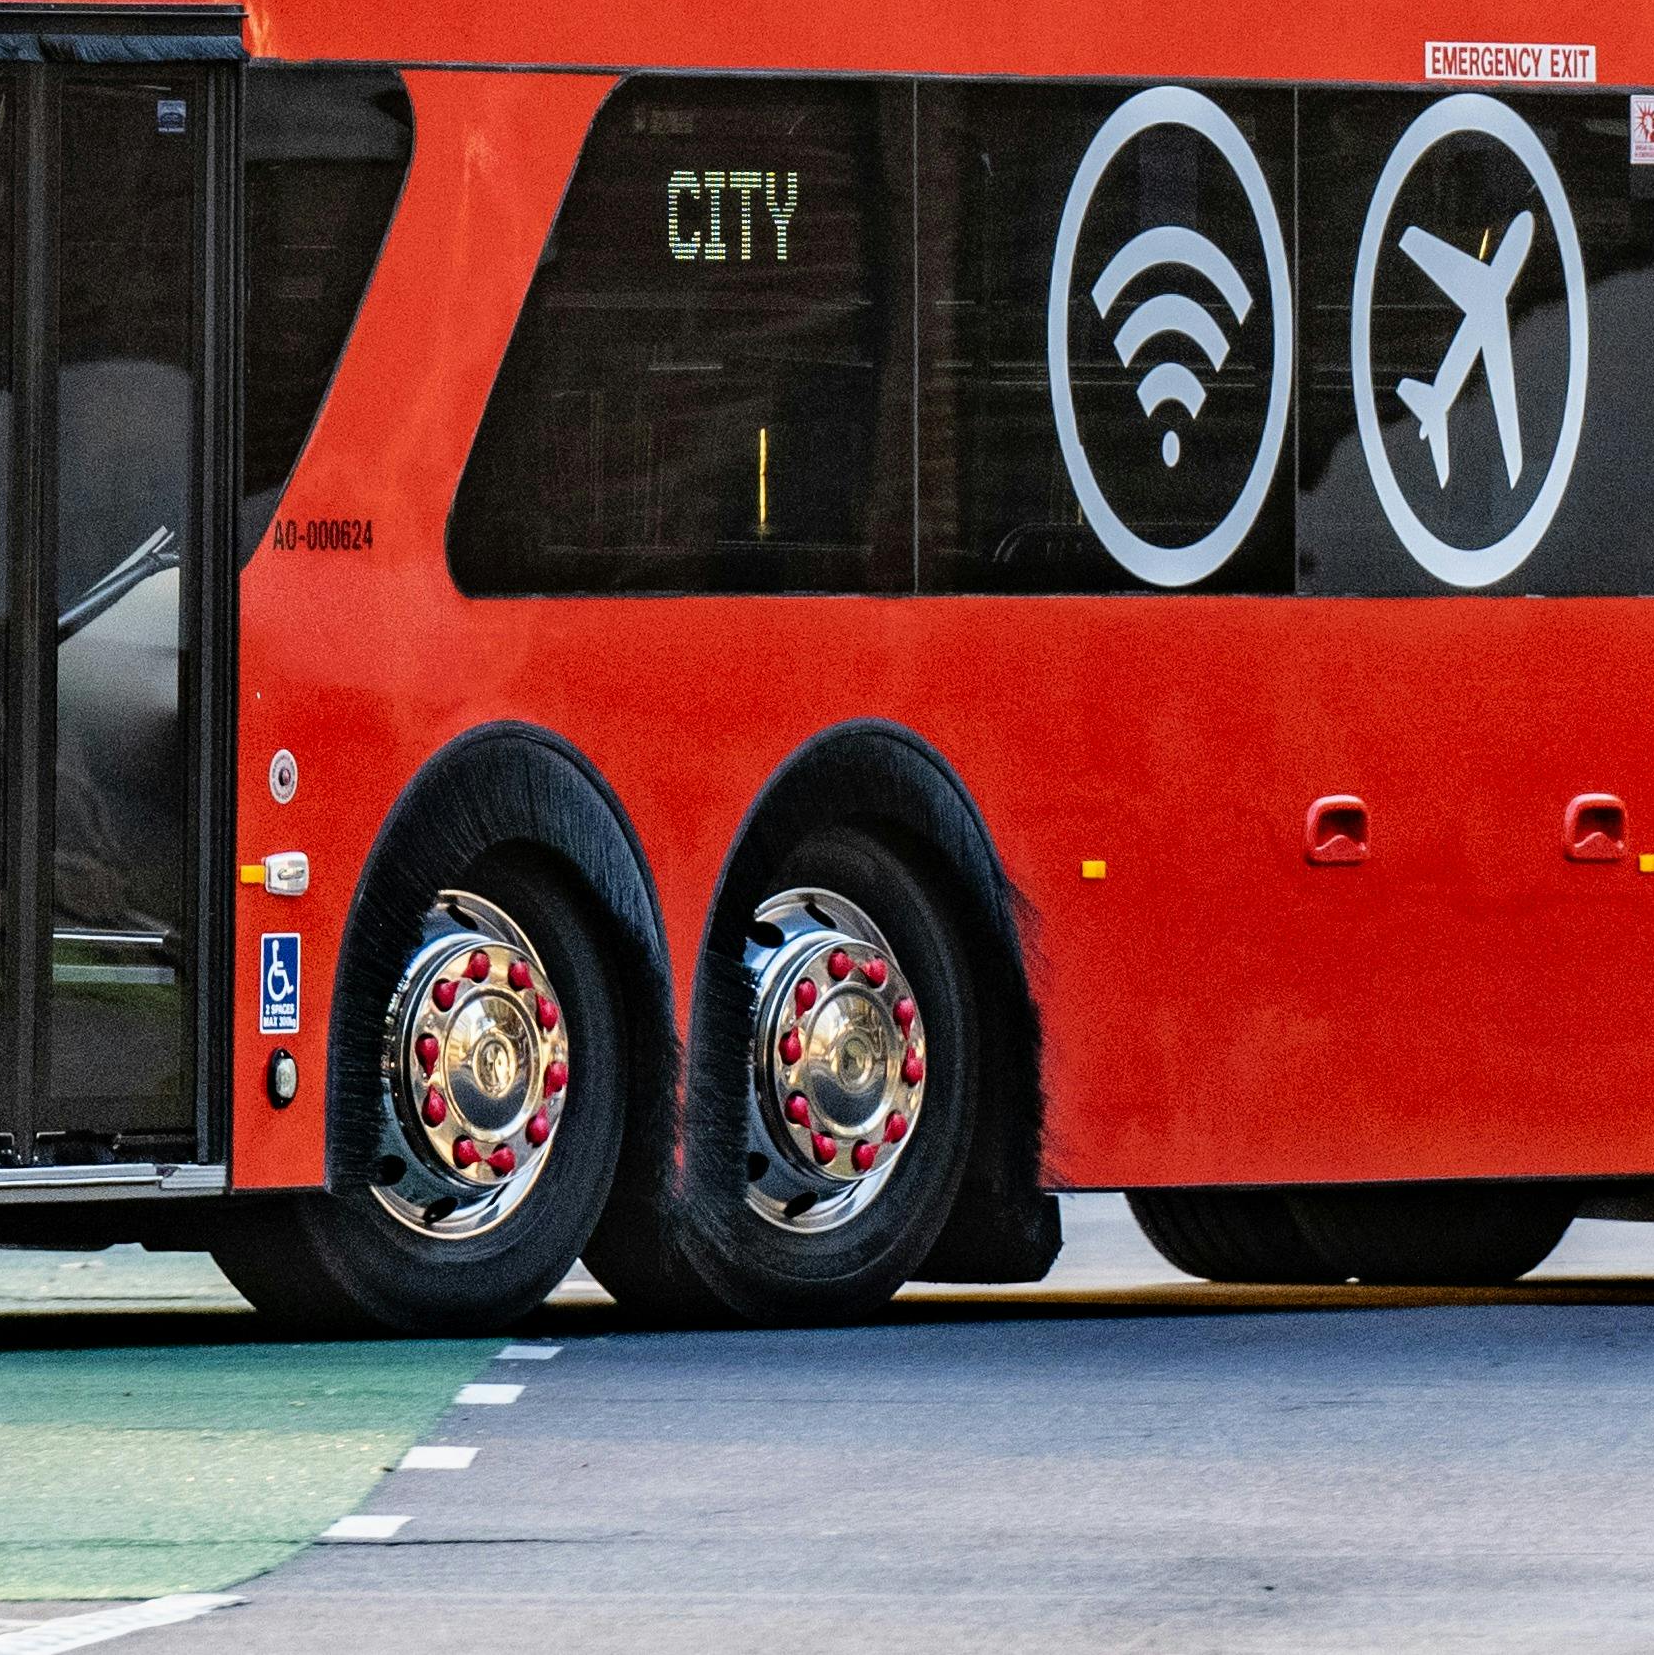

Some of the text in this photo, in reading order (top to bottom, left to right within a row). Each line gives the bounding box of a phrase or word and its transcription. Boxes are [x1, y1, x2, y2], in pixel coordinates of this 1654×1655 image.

[1431, 46, 1590, 78] EMERGENCY EXIT
[668, 170, 798, 260] CITY
